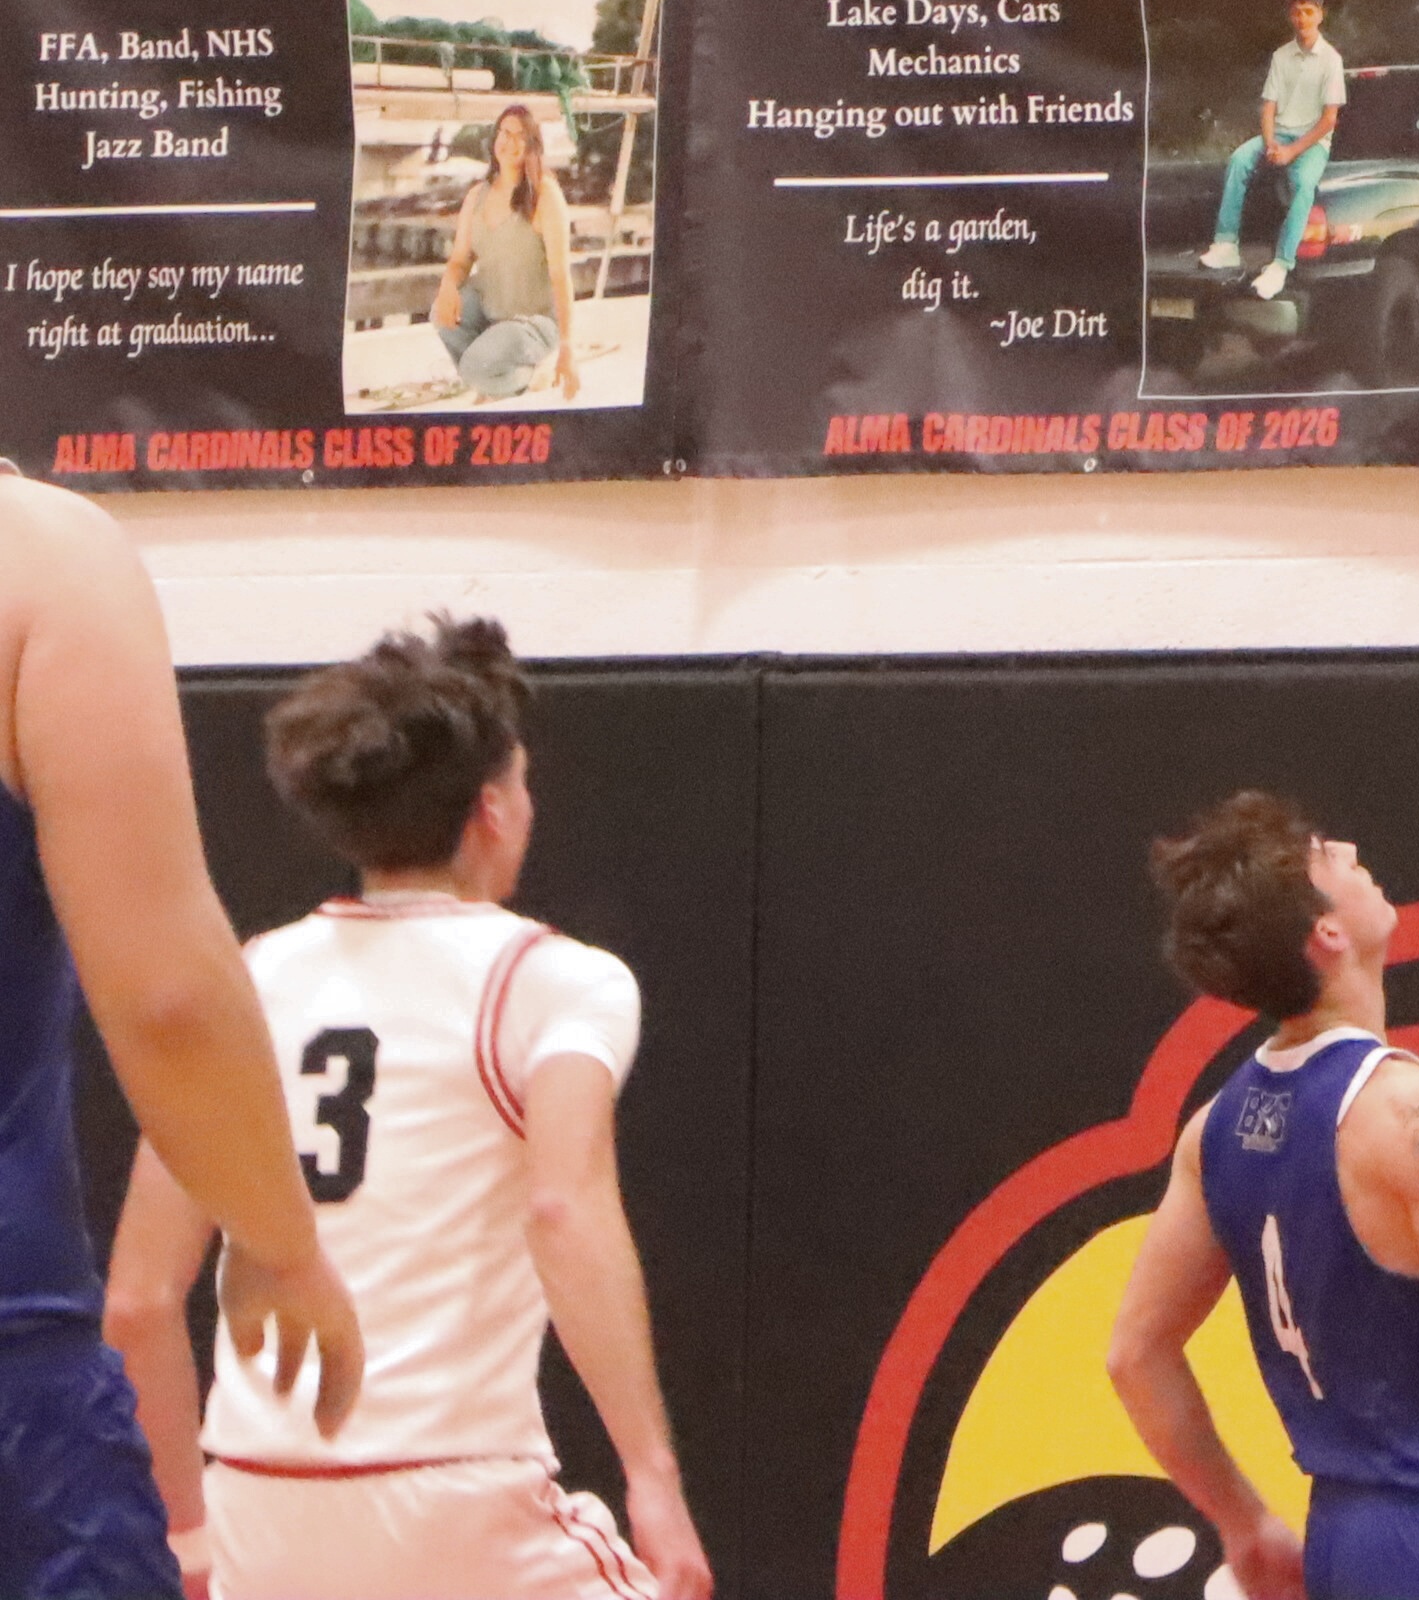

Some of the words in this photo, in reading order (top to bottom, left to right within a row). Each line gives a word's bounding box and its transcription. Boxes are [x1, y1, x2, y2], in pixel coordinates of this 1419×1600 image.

[41, 33, 108, 64] FFA,
[119, 28, 199, 61] Band,
[207, 29, 273, 56] NHS
[868, 44, 1020, 76] Mechanics
[36, 82, 168, 119] Hunting,
[178, 77, 282, 116] Fishing
[747, 99, 886, 138] Hanging
[895, 104, 943, 126] out
[952, 94, 1018, 125] with
[1028, 90, 1133, 123] Friends
[82, 131, 142, 169] Jazz
[151, 126, 228, 157] Band
[844, 210, 915, 255] Life's
[925, 220, 941, 241] a
[946, 208, 1036, 254] garden,
[6, 264, 17, 291] I
[27, 259, 83, 302] hope
[92, 257, 141, 300] they
[148, 267, 184, 300] say
[192, 265, 230, 298] my
[238, 264, 303, 285] name
[902, 268, 942, 313] dig
[952, 271, 978, 299] it.
[28, 315, 89, 359] right
[97, 323, 121, 345] at
[127, 313, 274, 358] graduation...
[1053, 309, 1107, 337] Dirt
[51, 432, 136, 473] ALMA
[150, 429, 313, 469] CARDINALS
[325, 428, 413, 466] CLASS
[425, 428, 459, 464] OF
[472, 425, 549, 464] 2026
[823, 415, 911, 453] ALMA
[923, 414, 1100, 452] CARDINALS
[1108, 412, 1207, 450] CLASS
[1218, 412, 1255, 449] OF
[1263, 410, 1338, 447] 2026
[299, 1027, 379, 1202] 3
[1260, 1214, 1324, 1401] 4
